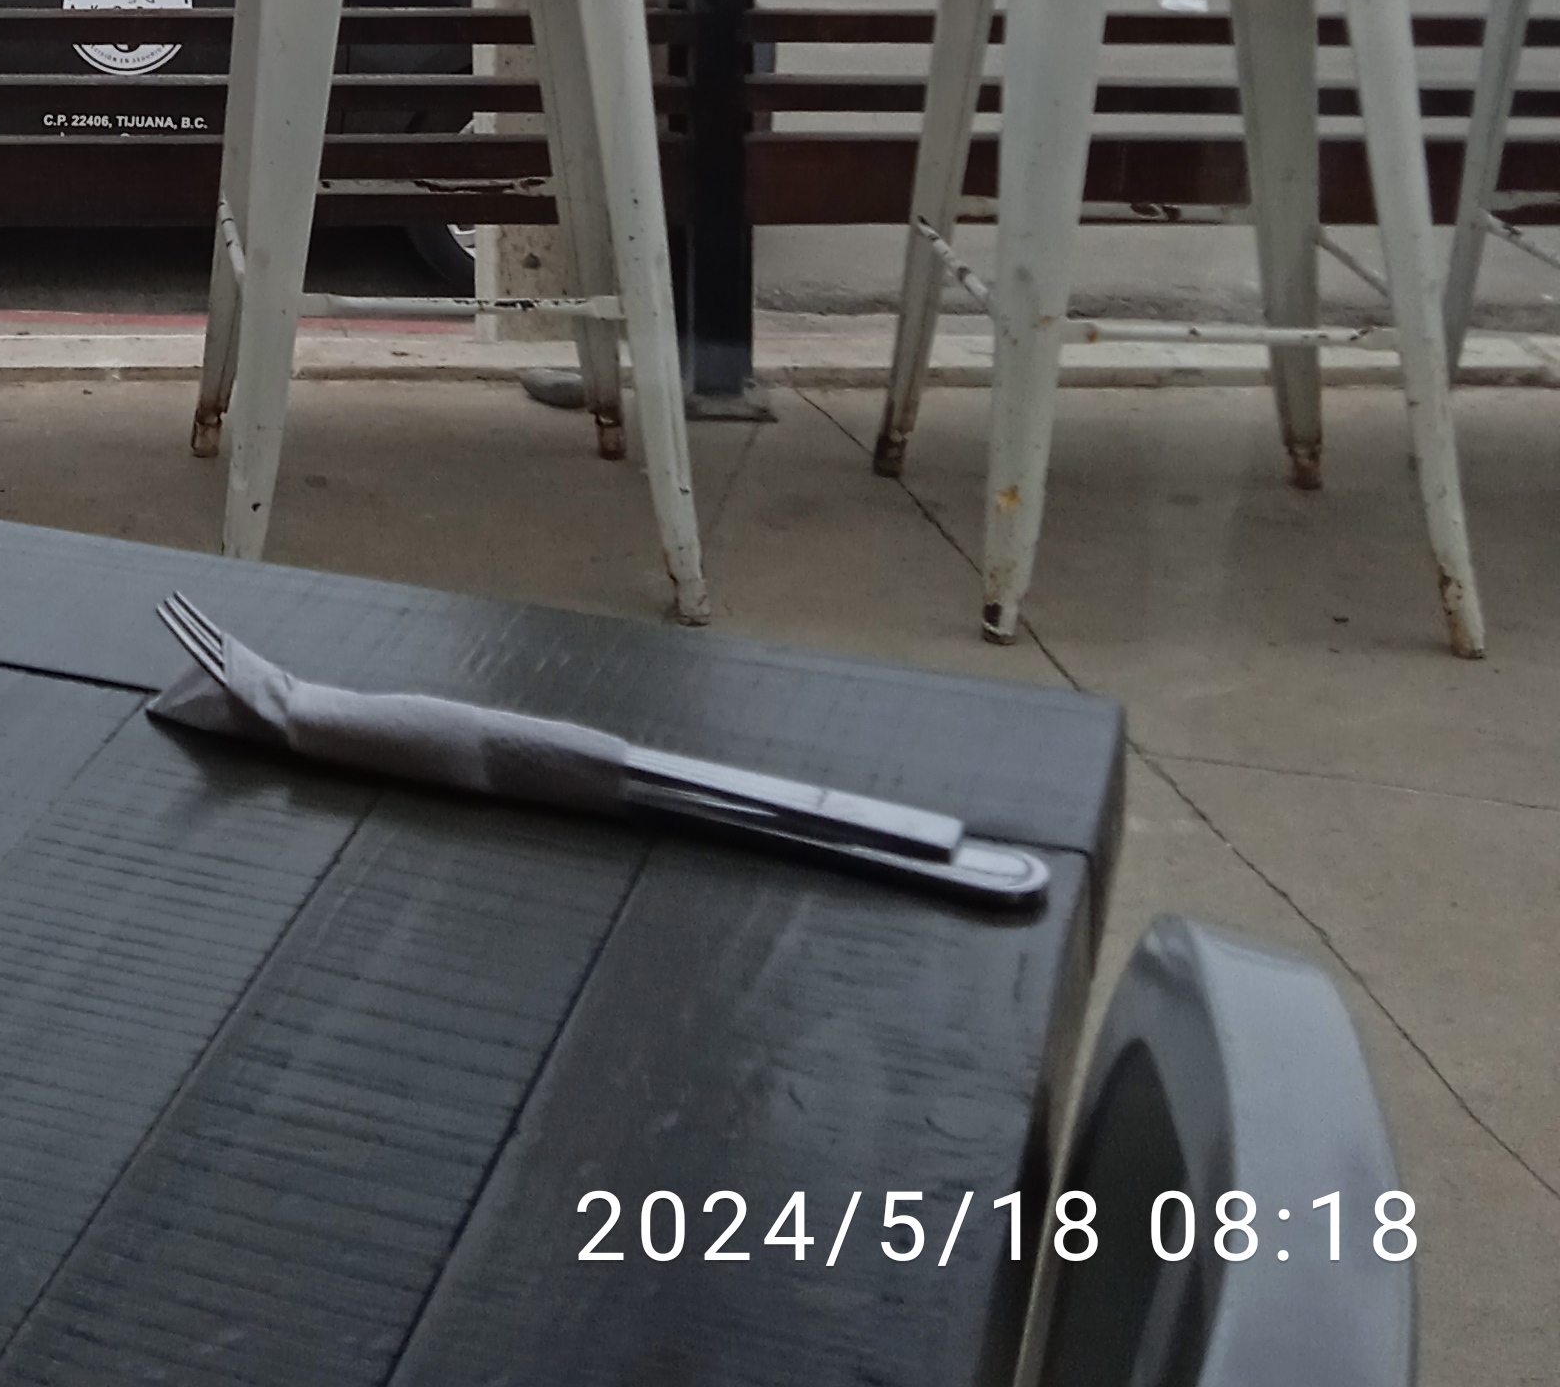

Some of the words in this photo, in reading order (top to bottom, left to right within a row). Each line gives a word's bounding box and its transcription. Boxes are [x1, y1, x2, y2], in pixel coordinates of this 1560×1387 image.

[43, 114, 68, 127] C.P.
[71, 115, 113, 129] 22406,
[116, 115, 178, 130] TIJUANA,
[180, 117, 208, 129] B.C.
